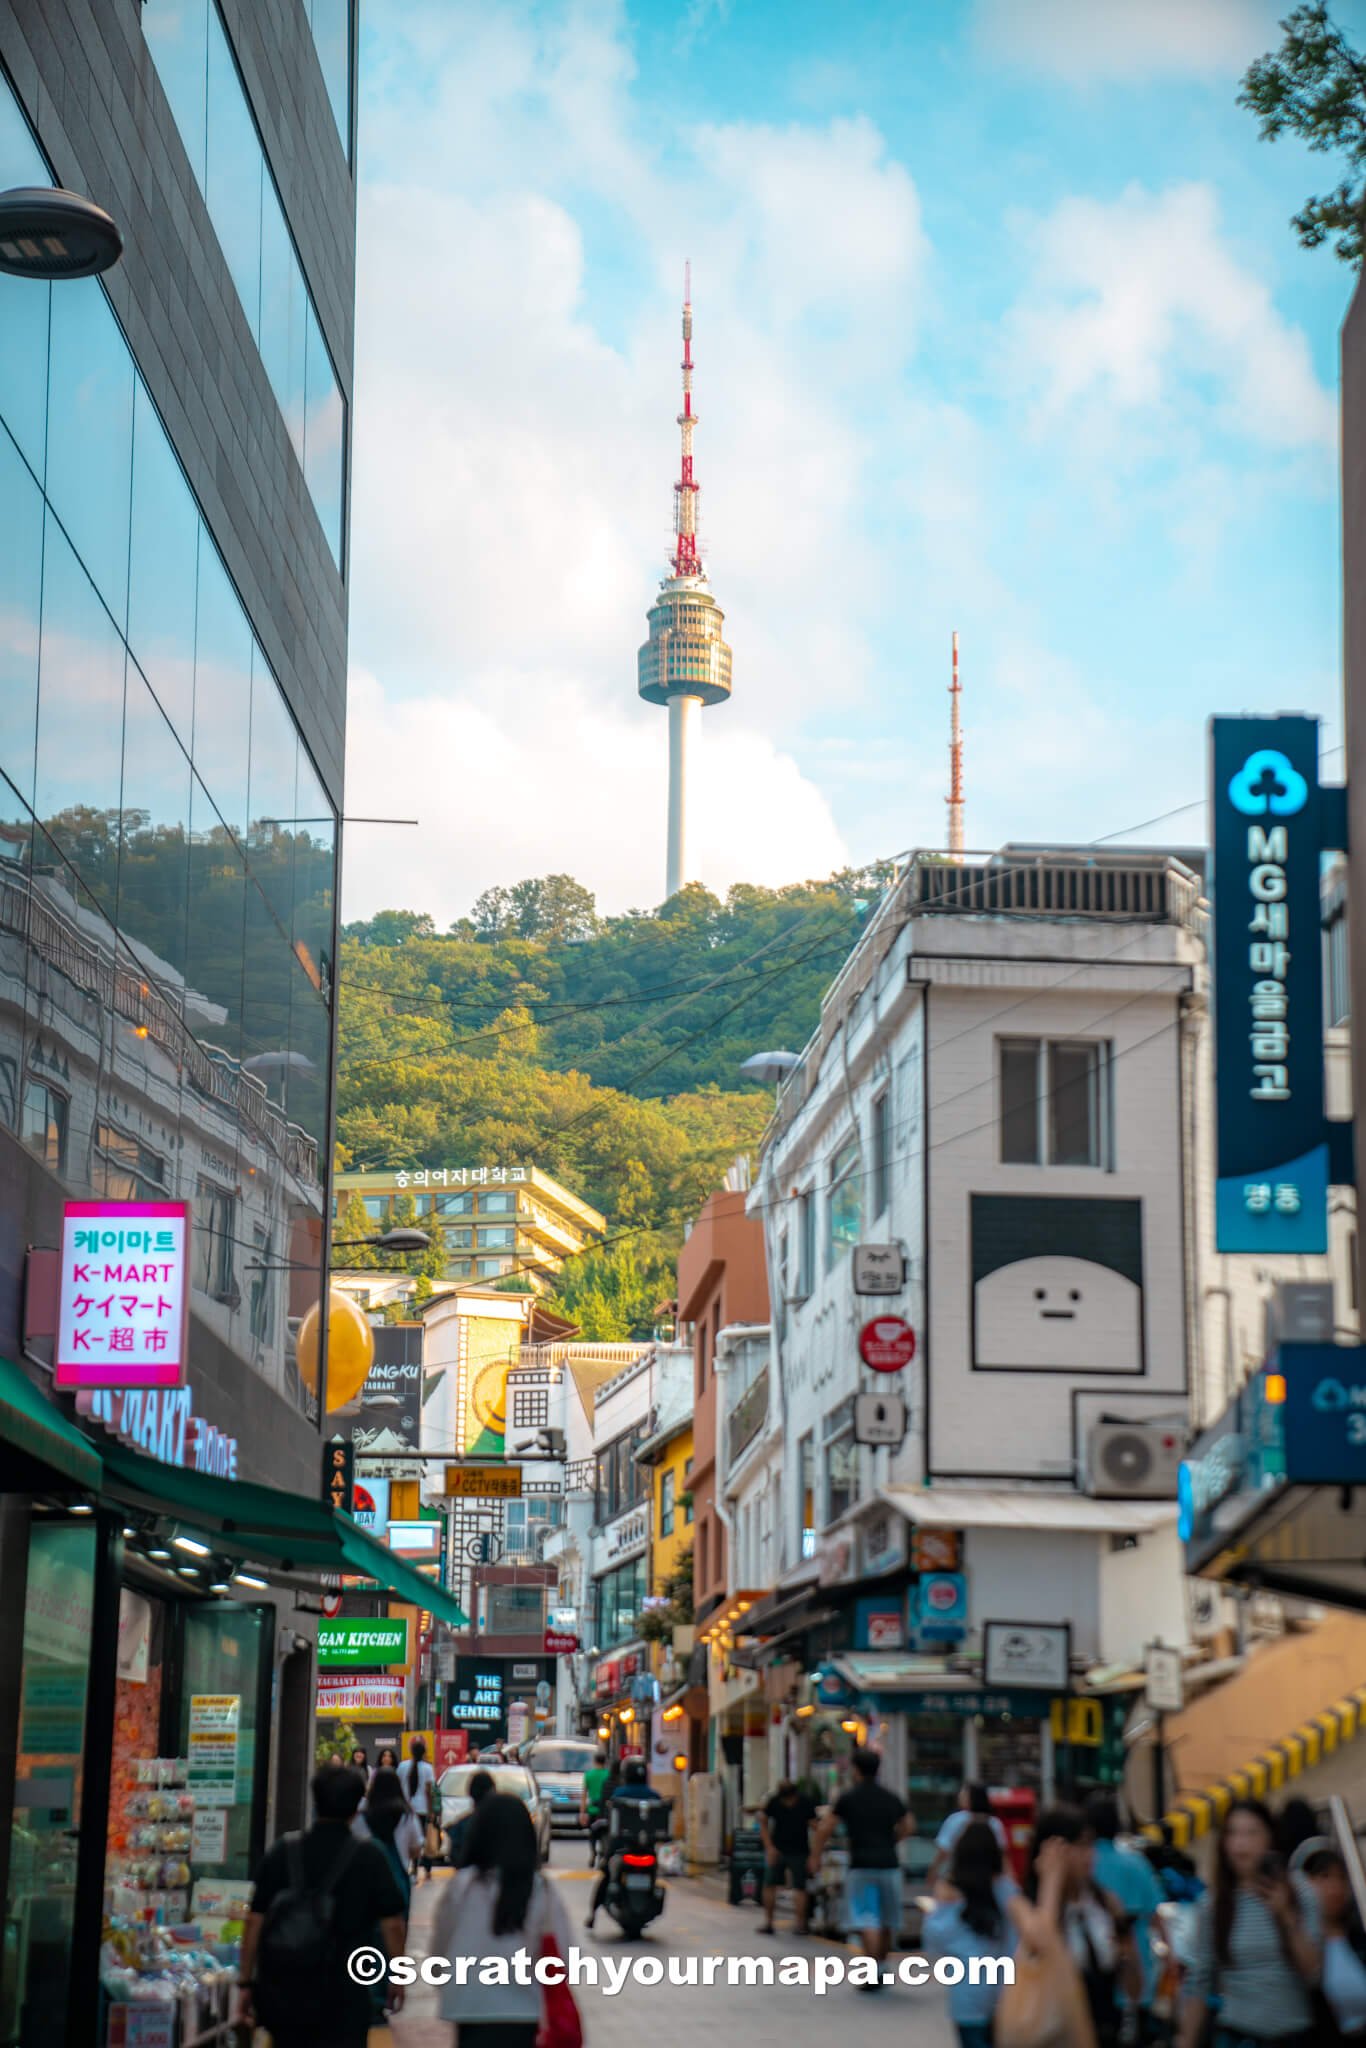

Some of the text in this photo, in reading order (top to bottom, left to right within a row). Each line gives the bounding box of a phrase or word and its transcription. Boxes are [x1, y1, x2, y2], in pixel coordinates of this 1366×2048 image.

[1248, 825, 1291, 1100] MG새마을금고
[394, 1166, 527, 1188] 숭의여자대학교
[74, 1230, 176, 1254] 케이마트
[73, 1263, 174, 1283] K-MART
[72, 1293, 173, 1318] ケイマート
[368, 1363, 420, 1379] UNGKU
[363, 1381, 396, 1391] TAURANT
[317, 1632, 402, 1647] GAN KITCHEN
[317, 1677, 355, 1686] TAURANT
[475, 1674, 502, 1689] THE
[364, 1693, 393, 1706] KOREA
[474, 1690, 502, 1703] ART
[452, 1705, 501, 1720] CENTER
